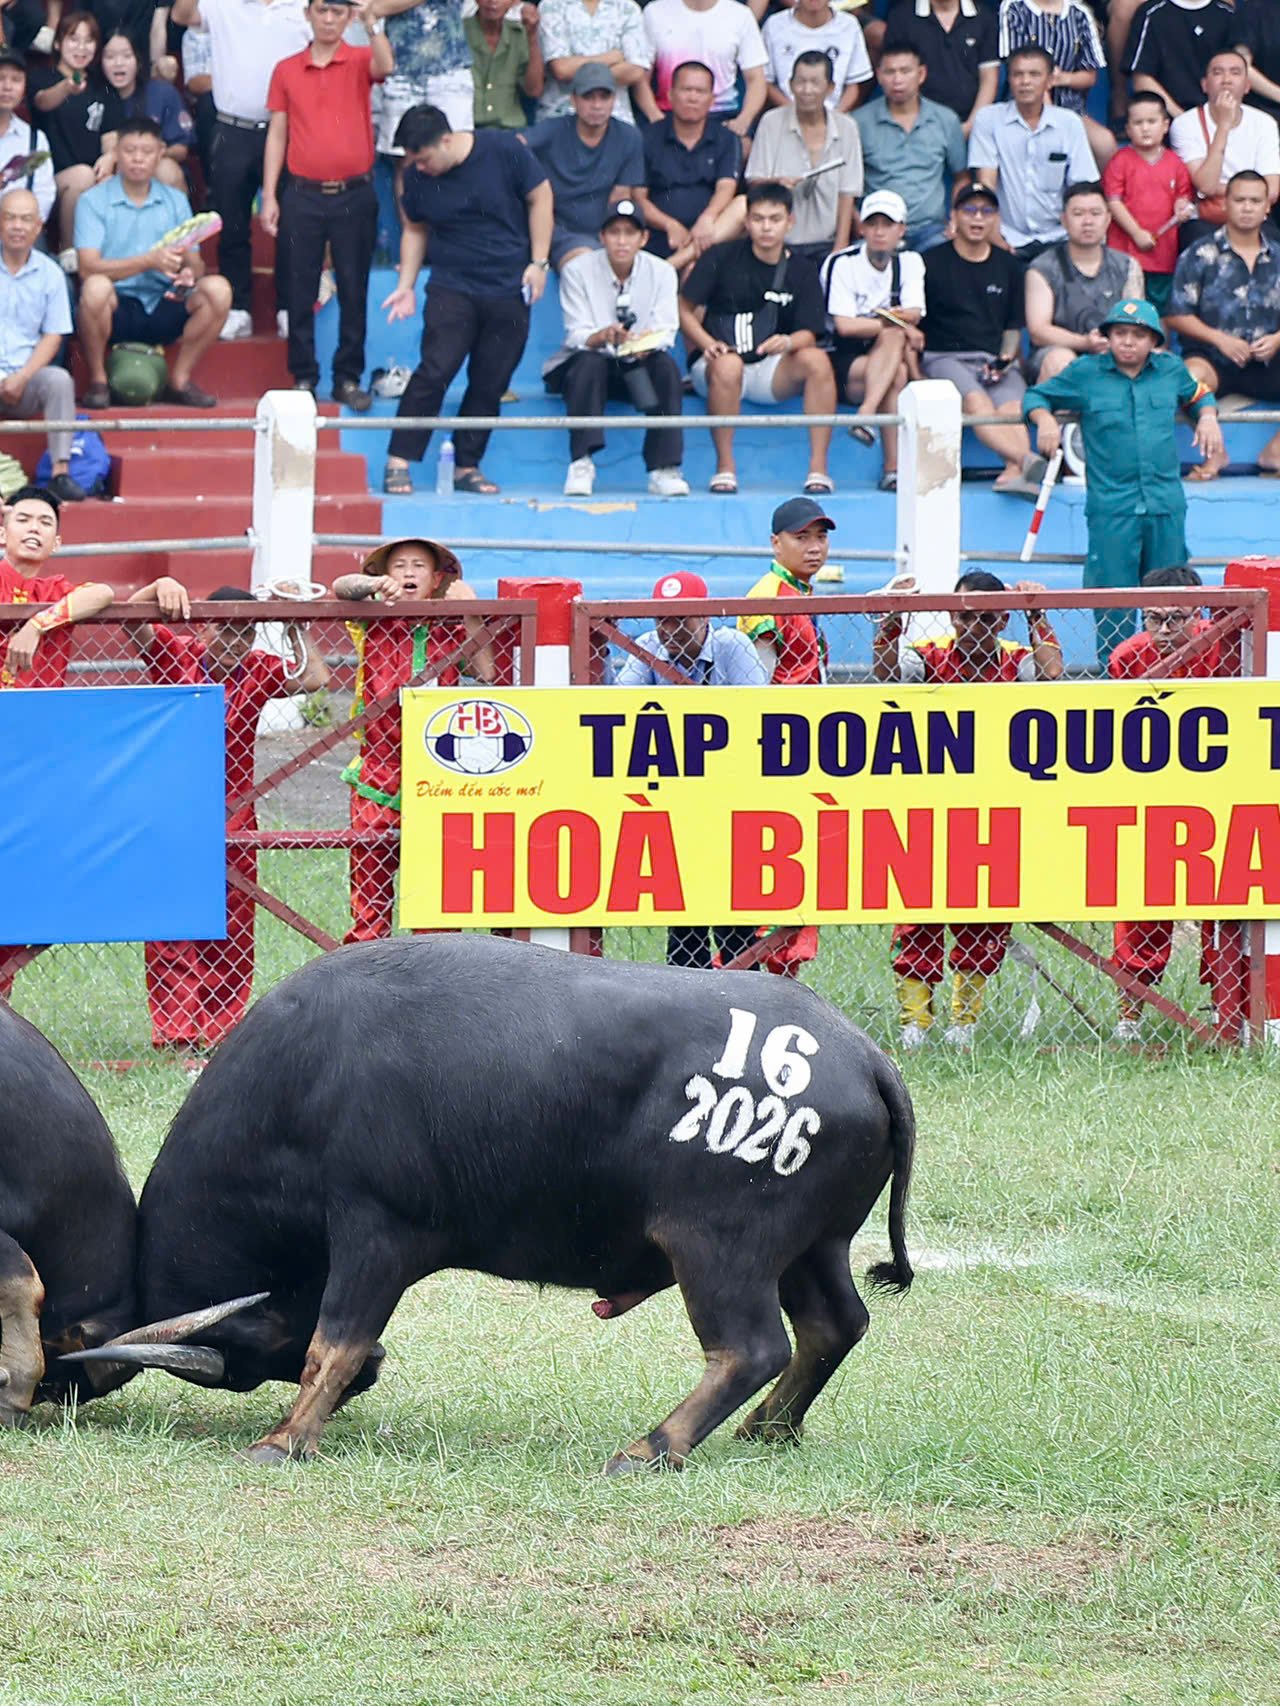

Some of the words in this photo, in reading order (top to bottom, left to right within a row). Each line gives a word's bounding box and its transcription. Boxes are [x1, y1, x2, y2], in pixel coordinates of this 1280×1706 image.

[457, 703, 502, 734] HB
[580, 701, 729, 790] TẬP
[757, 699, 975, 777] ĐOÀN
[1008, 691, 1229, 781] QUỐC
[441, 793, 686, 914] HOÀ
[730, 792, 1022, 912] BÌNH
[1067, 804, 1280, 908] TRA
[712, 1008, 819, 1098] 16
[670, 1074, 821, 1176] 2026
